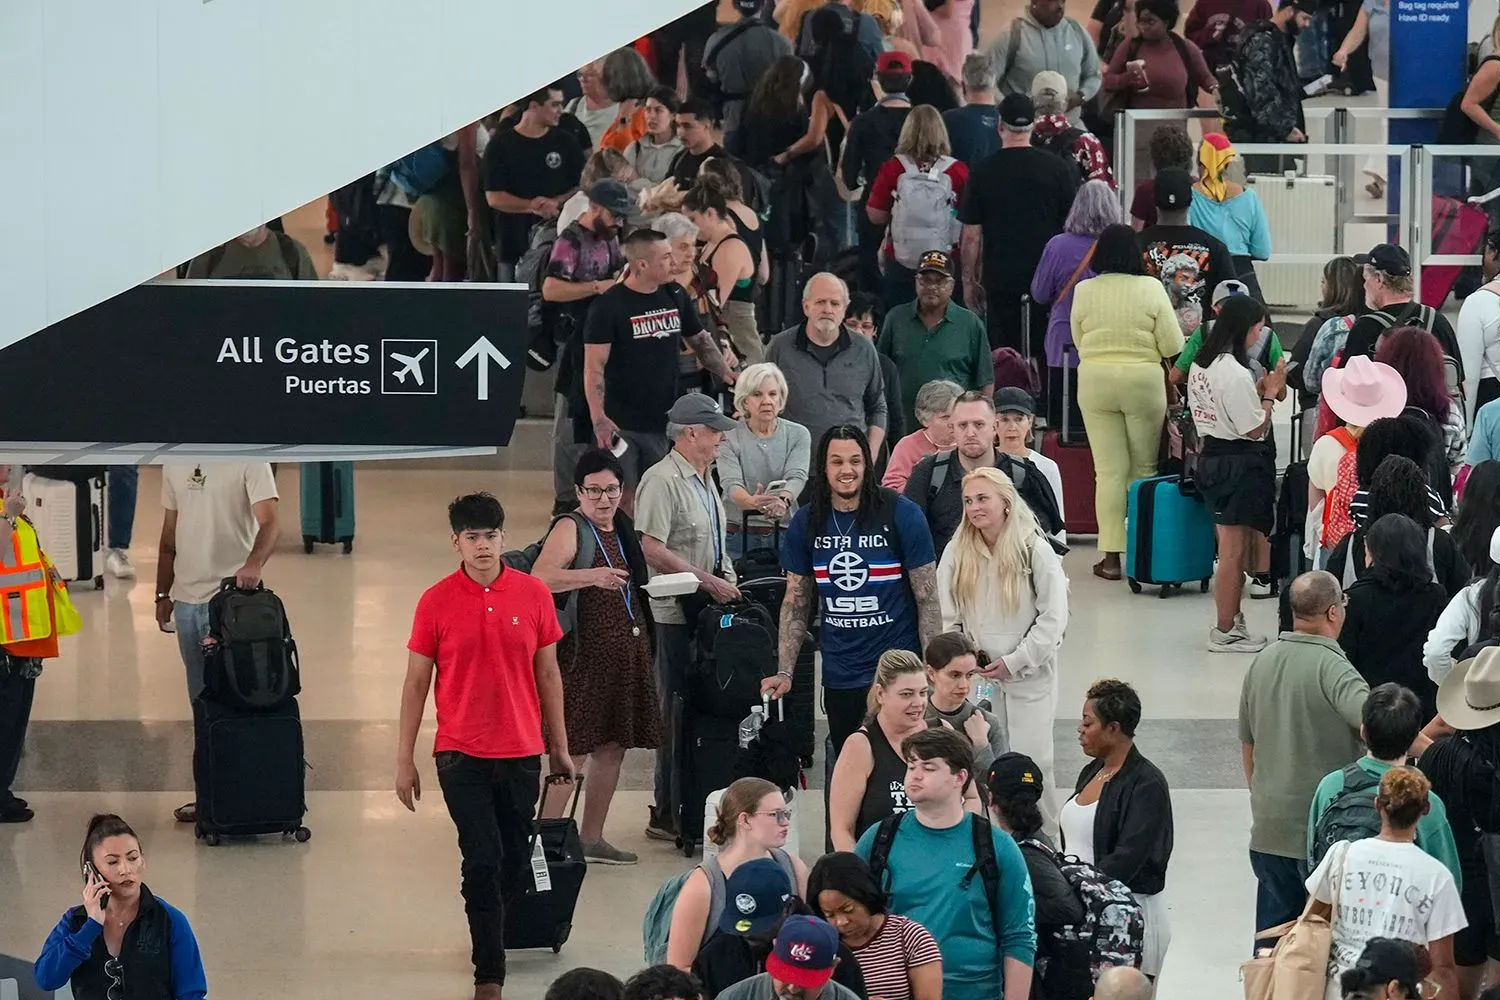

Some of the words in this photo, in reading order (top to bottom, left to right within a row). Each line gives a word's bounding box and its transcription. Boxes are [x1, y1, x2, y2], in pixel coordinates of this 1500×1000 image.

[1398, 1, 1413, 11] Bag
[1414, 2, 1426, 11] tag
[1427, 1, 1459, 10] required
[1398, 13, 1417, 22] Have
[1428, 14, 1450, 23] ready
[216, 336, 263, 364] All
[274, 337, 370, 365] Gates
[285, 375, 371, 394] Puertas
[814, 535, 852, 550] OSTA
